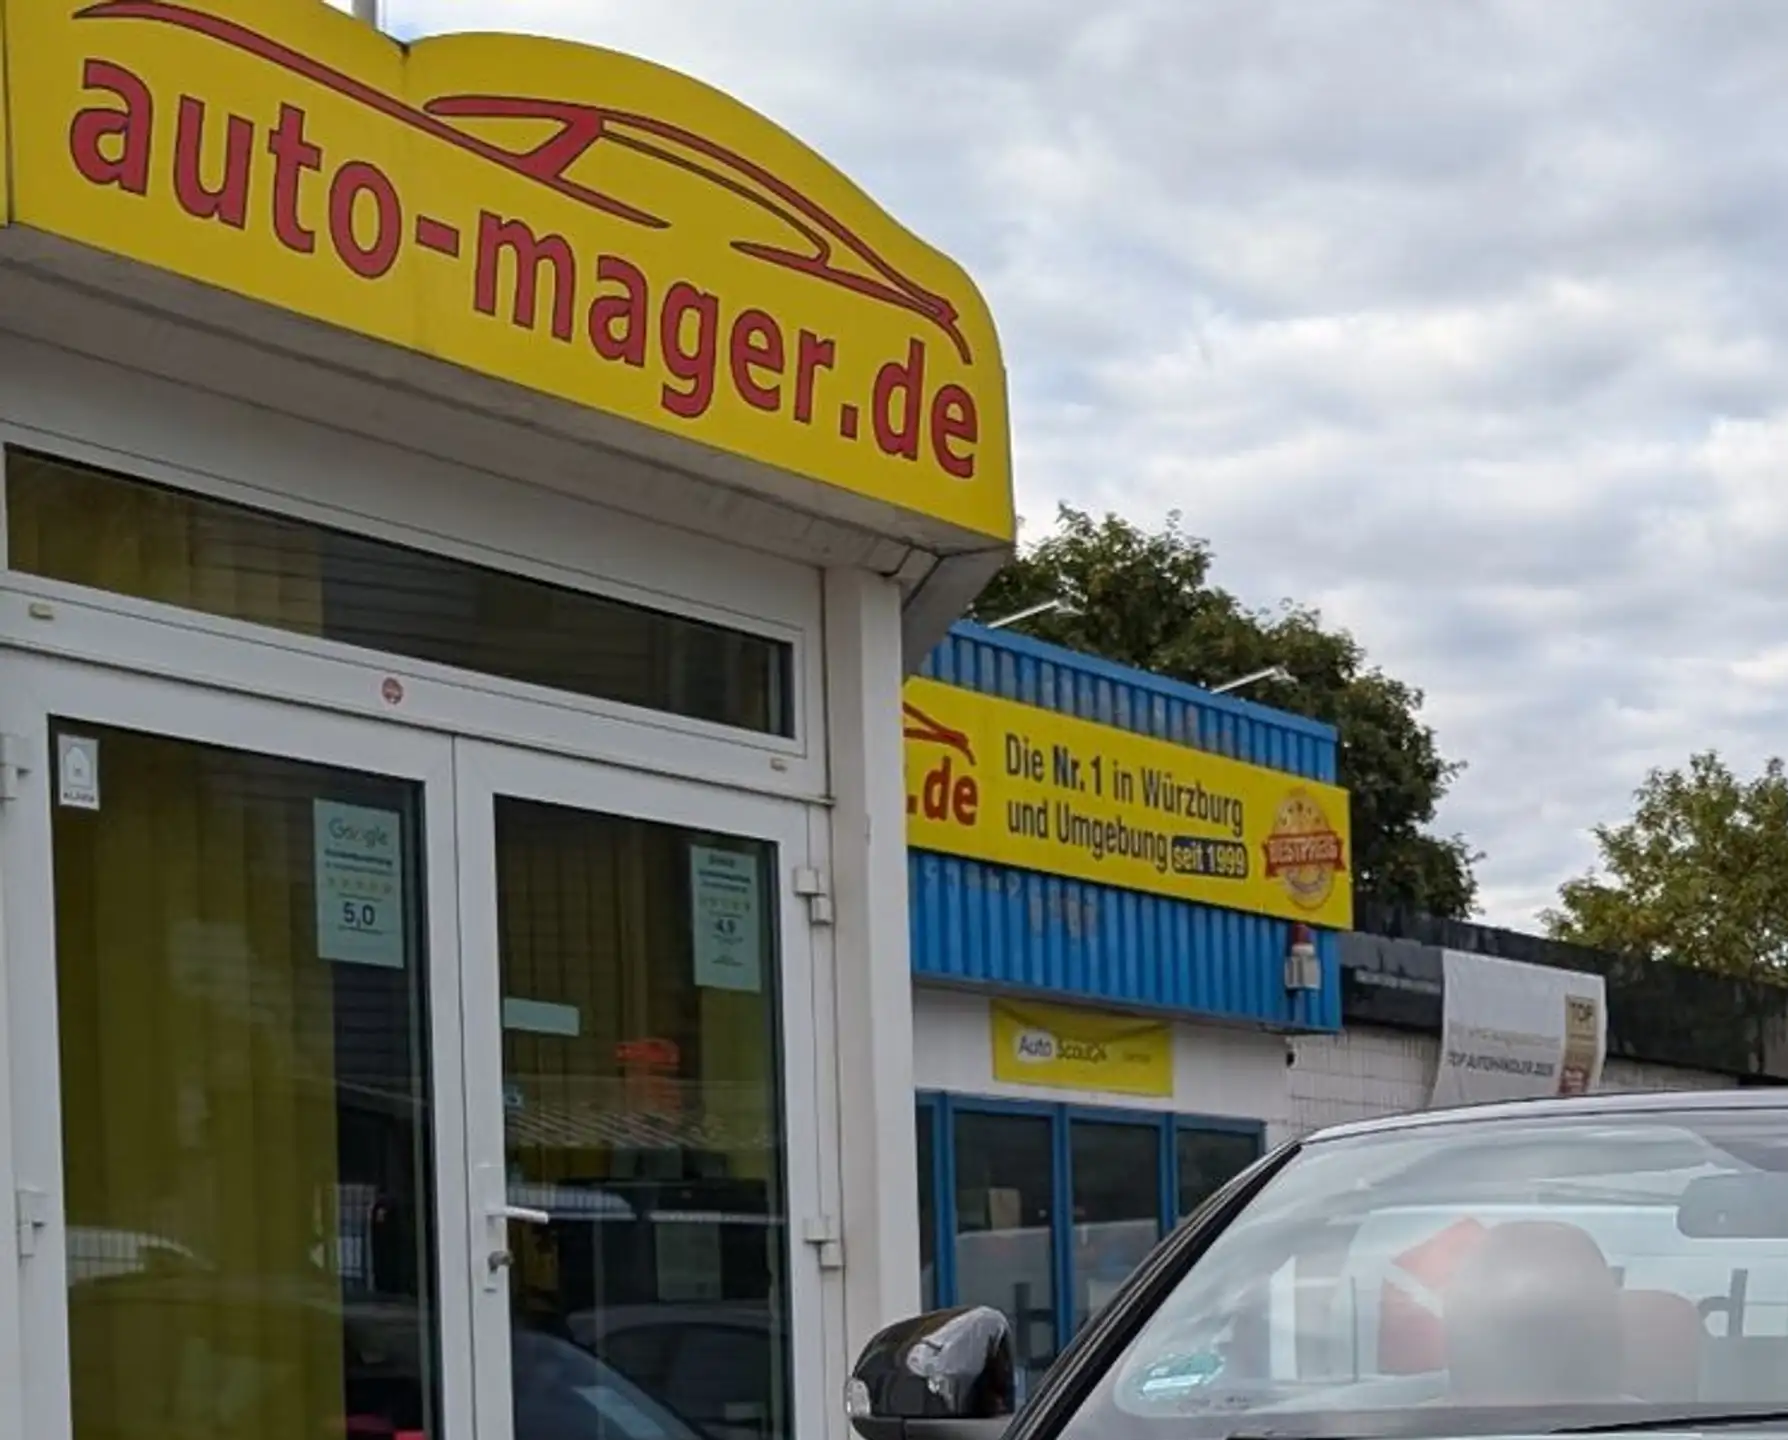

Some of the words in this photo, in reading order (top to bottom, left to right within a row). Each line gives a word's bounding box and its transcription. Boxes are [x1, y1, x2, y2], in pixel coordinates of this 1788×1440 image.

[70, 58, 980, 479] auto-mager.de
[1005, 733, 1045, 781] Die
[1053, 745, 1085, 792] Nr.
[1091, 755, 1102, 794] 1
[1113, 760, 1135, 806] in
[1141, 767, 1244, 838] Würzburg
[1007, 801, 1048, 840] und
[1057, 808, 1169, 873] Umgebung
[1172, 841, 1203, 873] seit
[1208, 843, 1246, 877] 1999
